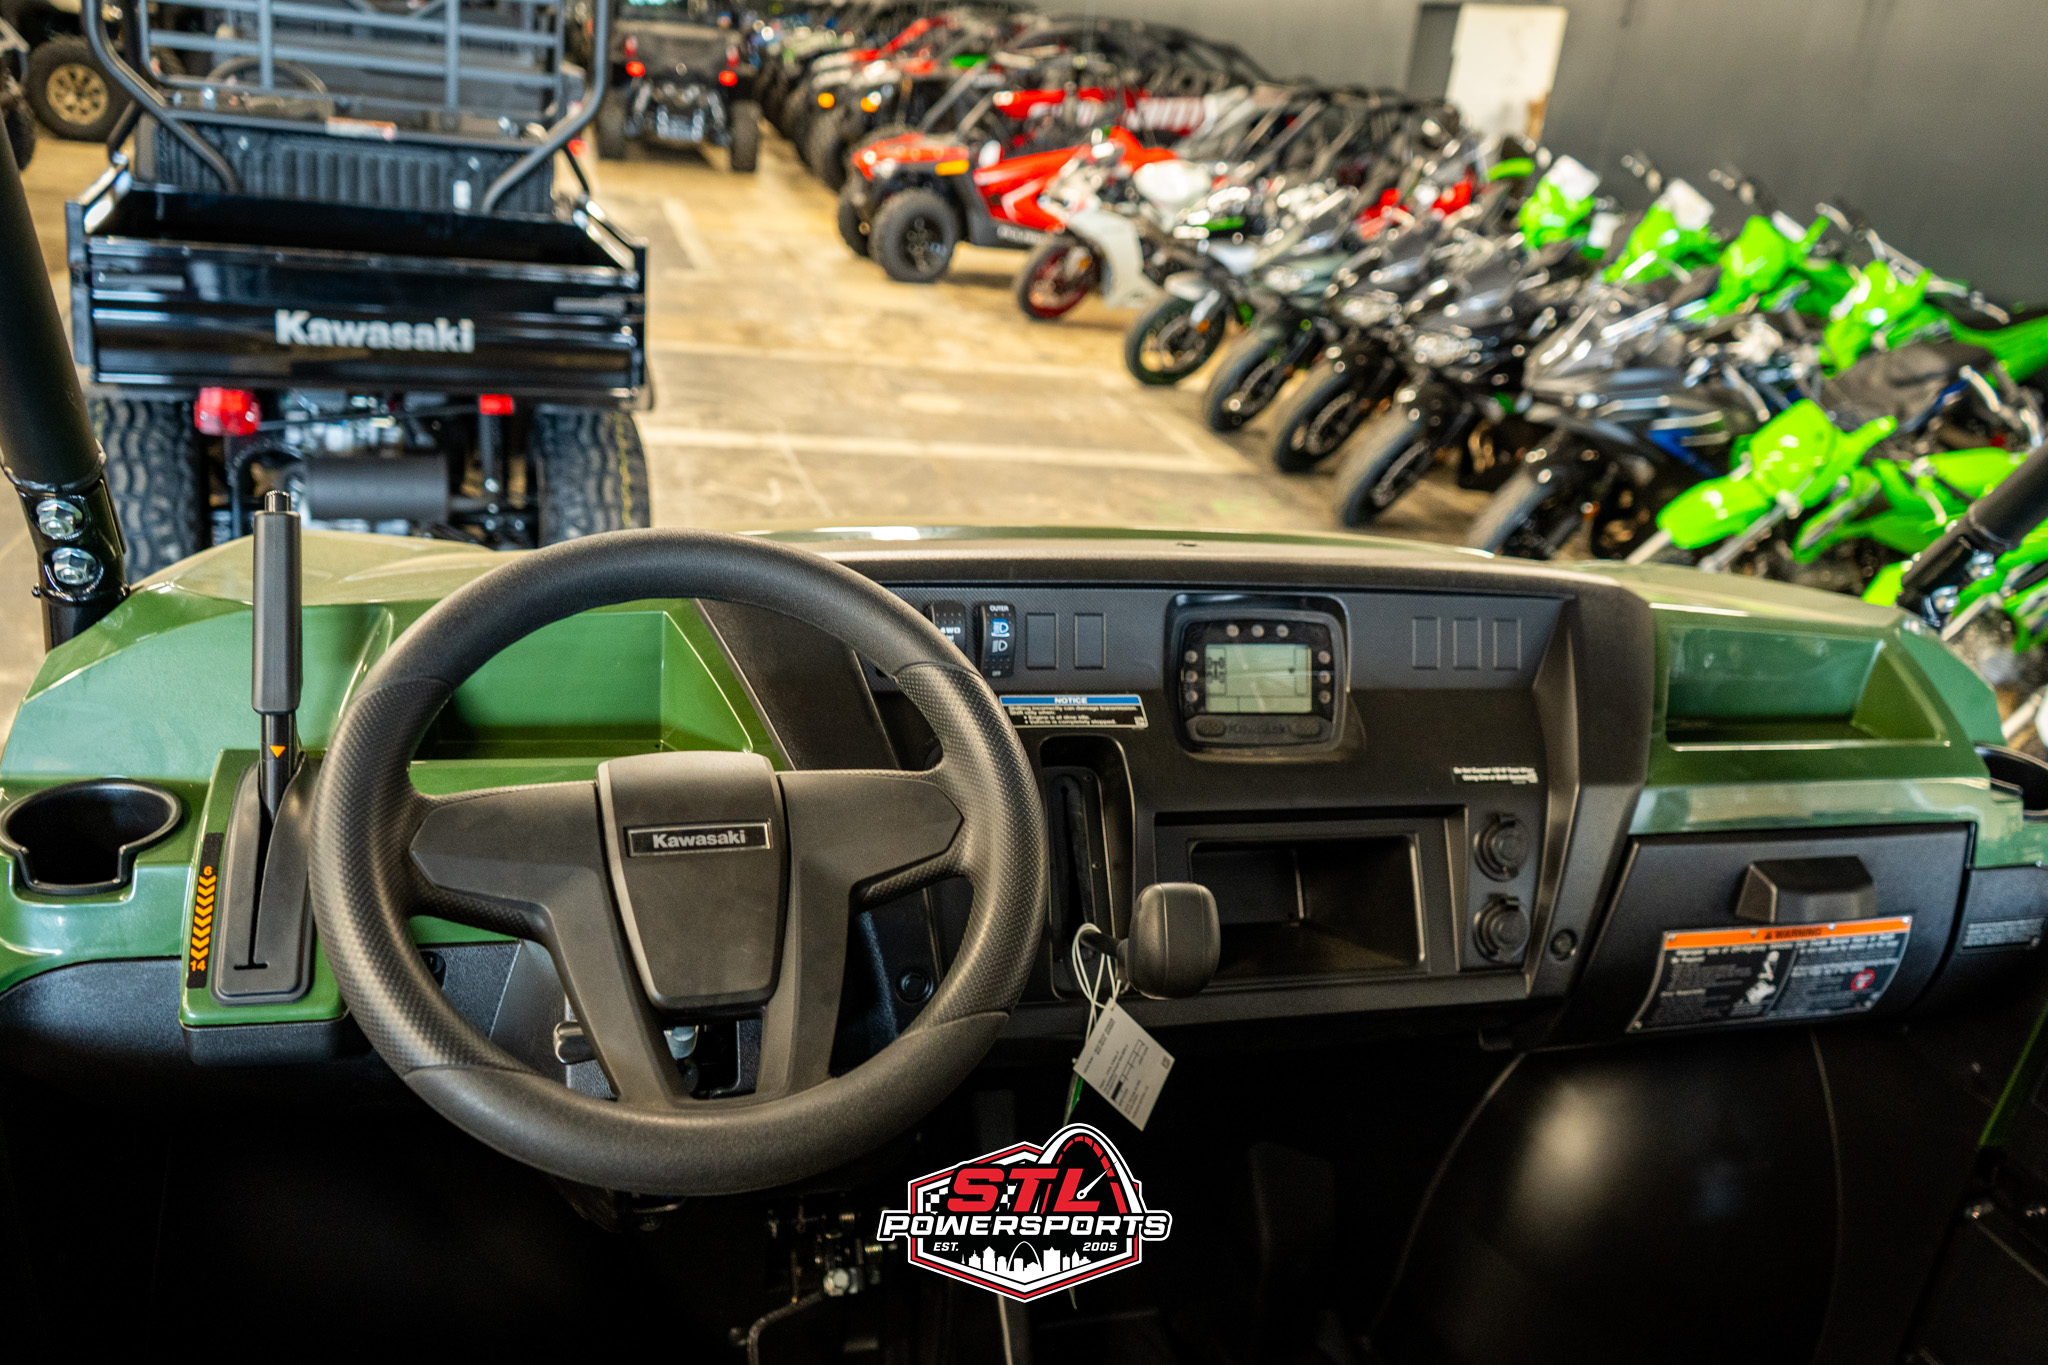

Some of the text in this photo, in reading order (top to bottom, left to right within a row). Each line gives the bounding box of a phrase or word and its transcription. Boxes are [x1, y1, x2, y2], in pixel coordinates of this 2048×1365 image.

[275, 309, 475, 353] Kawasaki
[1054, 696, 1087, 704] NOTICE
[652, 830, 746, 849] Kawasaki
[203, 865, 213, 876] 6
[1775, 928, 1821, 939] WARNING
[190, 960, 206, 972] 14
